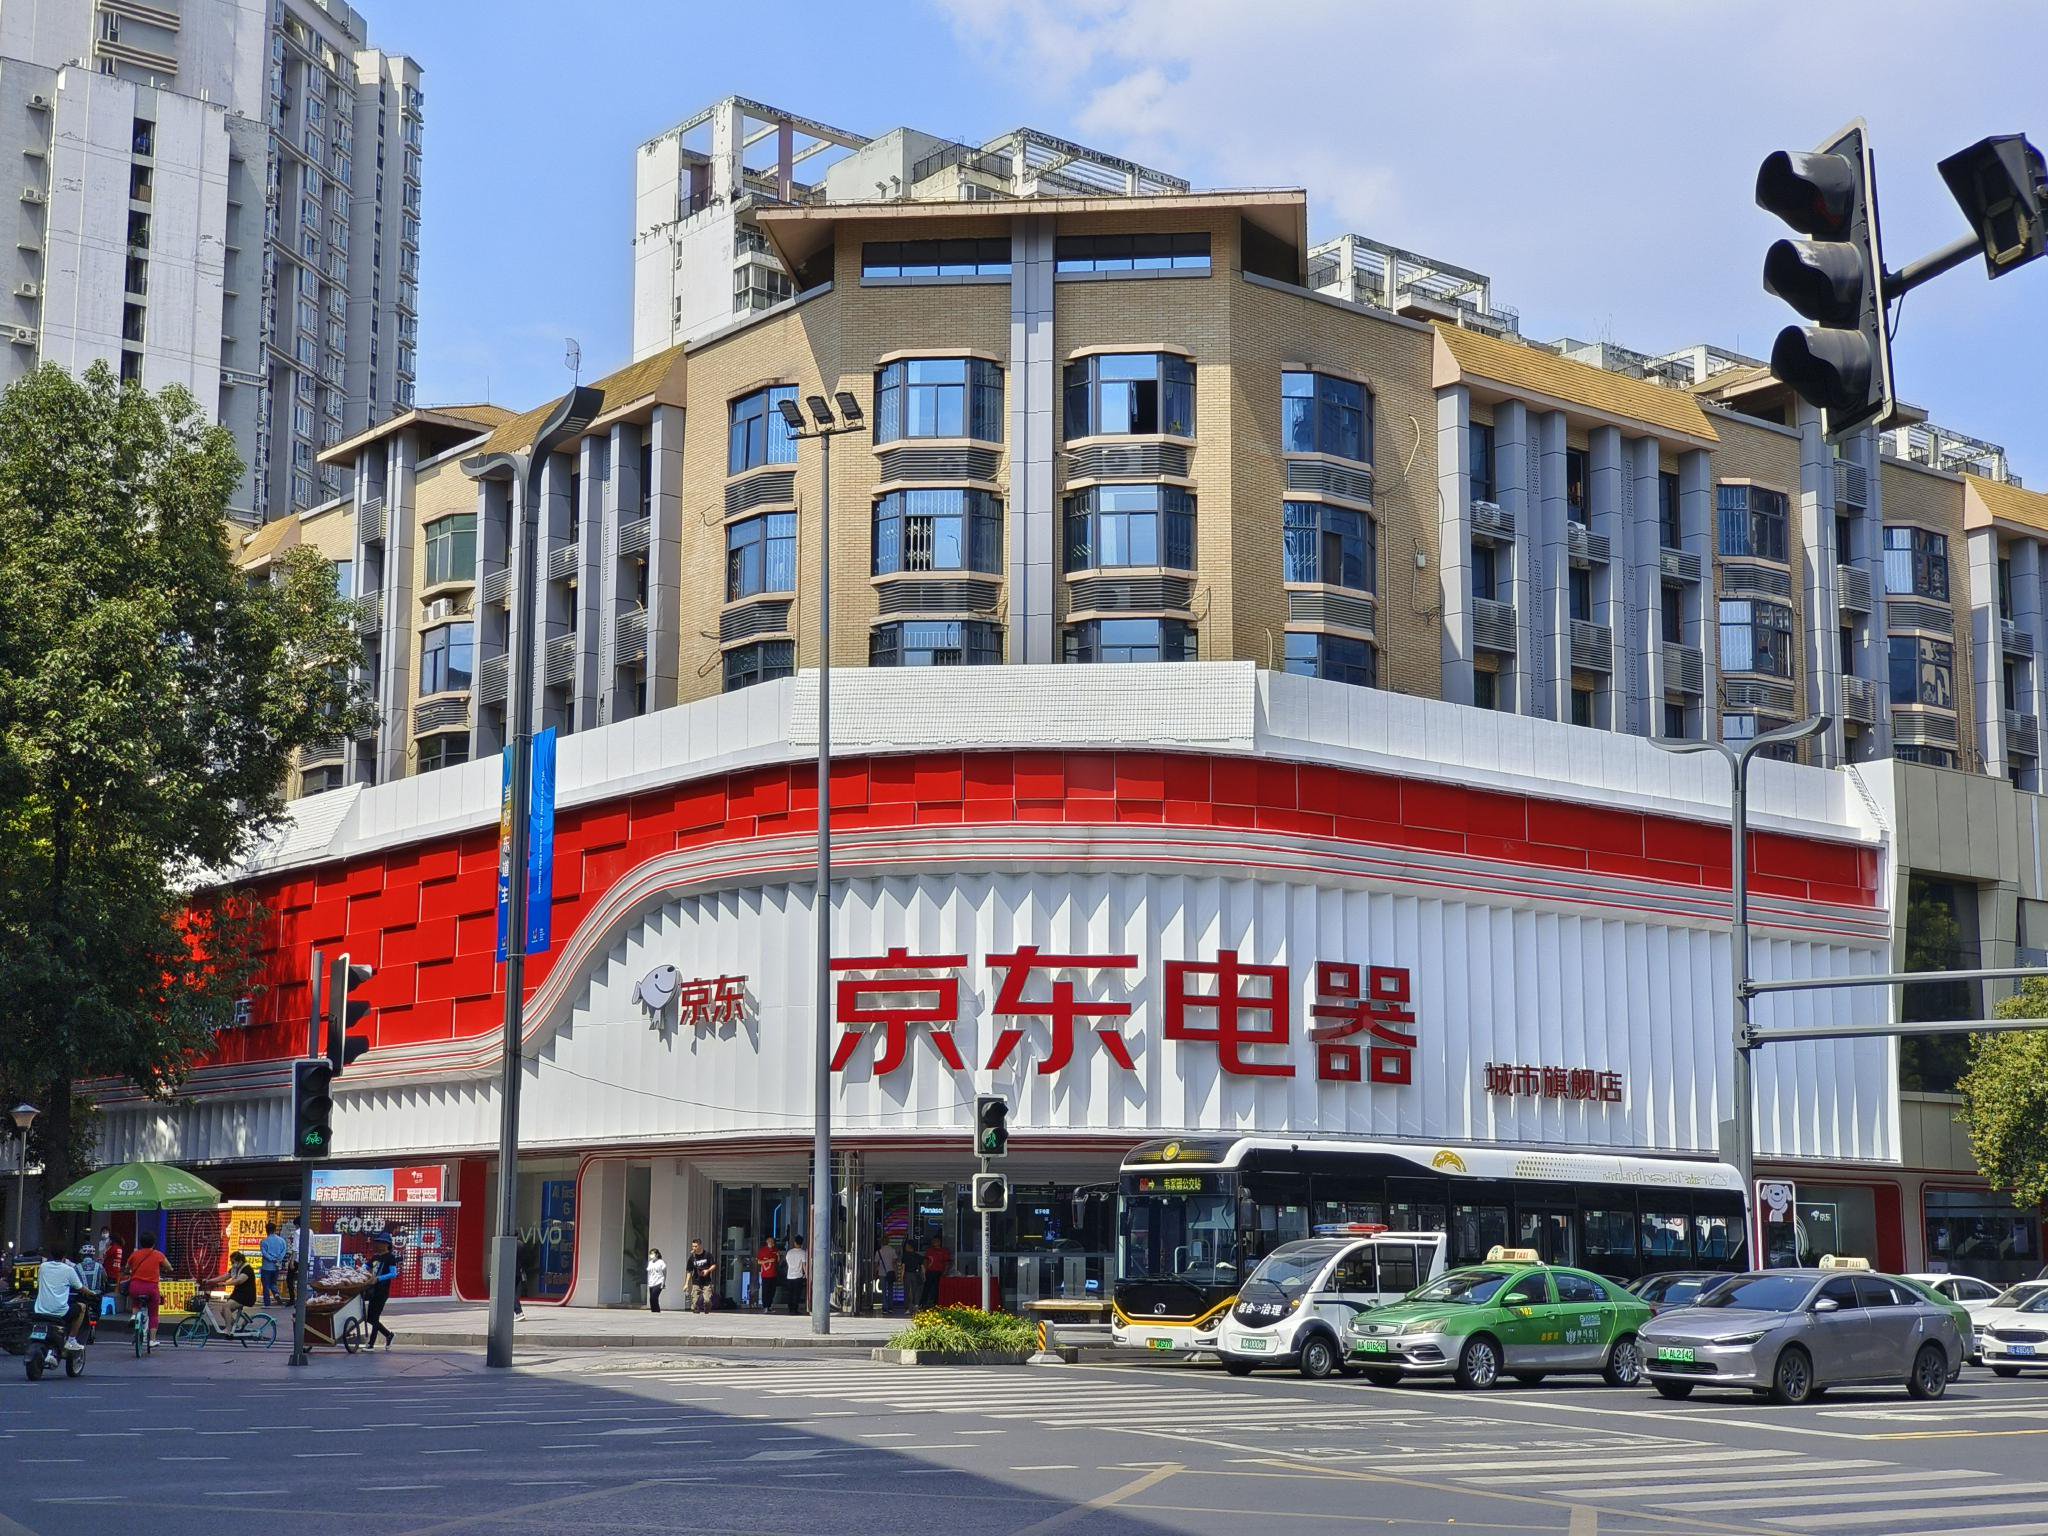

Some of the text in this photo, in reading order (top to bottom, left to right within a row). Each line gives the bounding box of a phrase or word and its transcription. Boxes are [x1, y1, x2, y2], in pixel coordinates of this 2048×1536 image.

[680, 975, 748, 1025] 京东
[828, 945, 1417, 1086] 京东电器
[1484, 1063, 1622, 1102] 城市旗舰店
[316, 1185, 387, 1202] 京东电器城市旗舰店
